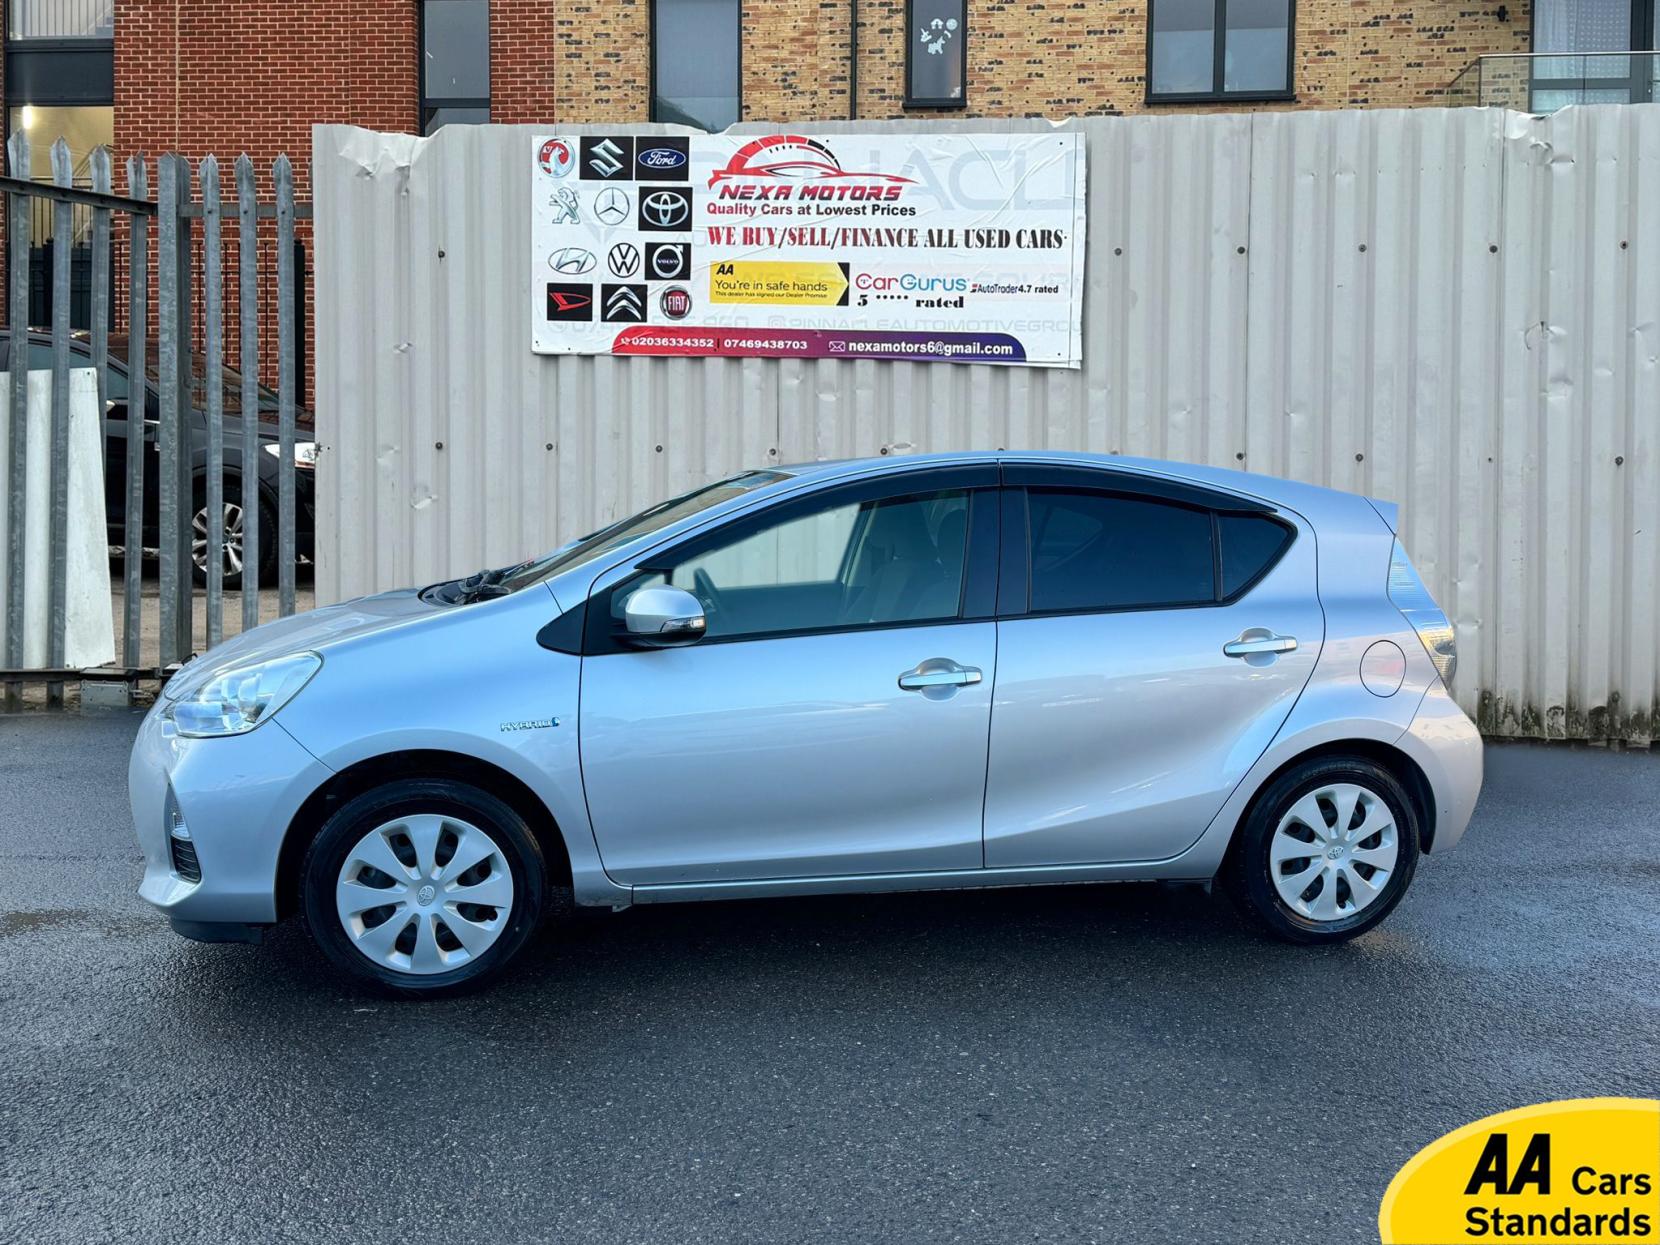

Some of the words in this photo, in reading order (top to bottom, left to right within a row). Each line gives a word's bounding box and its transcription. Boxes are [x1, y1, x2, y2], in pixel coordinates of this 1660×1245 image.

[647, 151, 676, 165] Ford
[719, 185, 793, 201] NEXA
[799, 185, 903, 202] MOTORS
[707, 202, 757, 217] Quality
[761, 203, 793, 216] Cars
[797, 204, 811, 216] at
[816, 204, 867, 216] Lowest
[871, 204, 917, 217] Prices
[707, 226, 737, 246] WE
[742, 226, 919, 250] BUY/SELL/FINANCE
[924, 228, 959, 248] ALL
[964, 228, 1011, 249] USED
[1015, 228, 1064, 249] CARS
[716, 264, 734, 275] AA
[715, 280, 750, 290] You're
[753, 281, 763, 290] in
[766, 281, 790, 291] safe
[793, 282, 828, 291] hands
[856, 273, 967, 291] CarGurus
[1034, 285, 1059, 294] rated
[667, 295, 686, 311] FIAT
[857, 294, 868, 307] 5
[916, 296, 964, 308] rated
[631, 337, 714, 348] 02036334352
[723, 338, 808, 349] 07469438703
[849, 341, 1013, 356] nexamotors6@gmail.com
[500, 719, 551, 732] HYBRID
